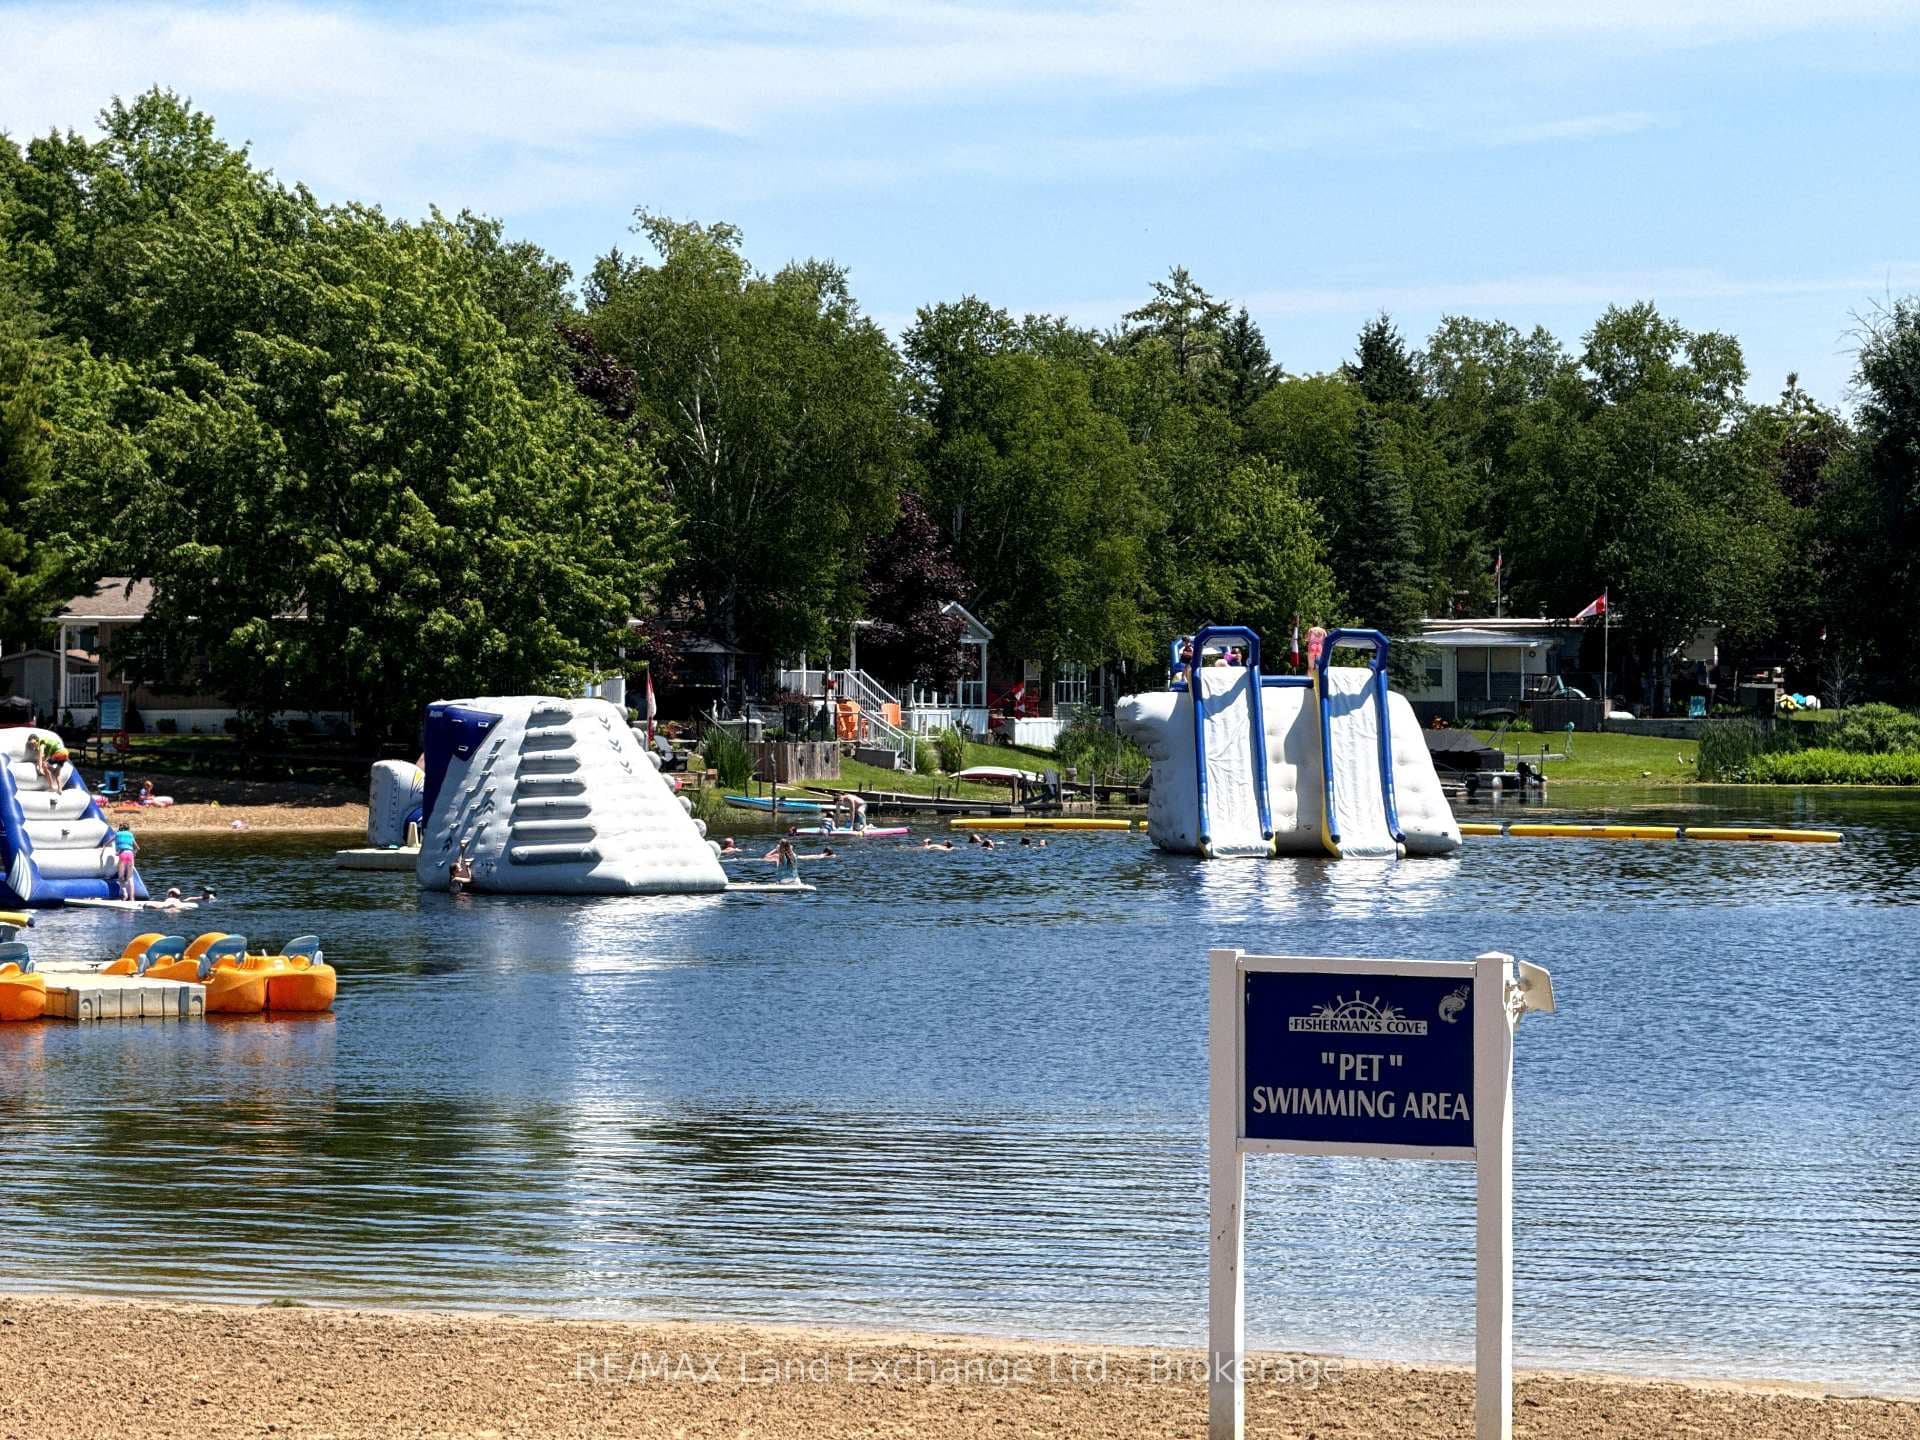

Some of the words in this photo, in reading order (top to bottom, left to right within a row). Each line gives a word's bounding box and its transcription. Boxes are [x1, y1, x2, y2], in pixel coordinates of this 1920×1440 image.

[1293, 1018, 1382, 1033] FISHERMAN'S
[1386, 1021, 1422, 1034] COVE
[1253, 1086, 1395, 1118] SWIMMING
[1402, 1092, 1470, 1121] AREA
